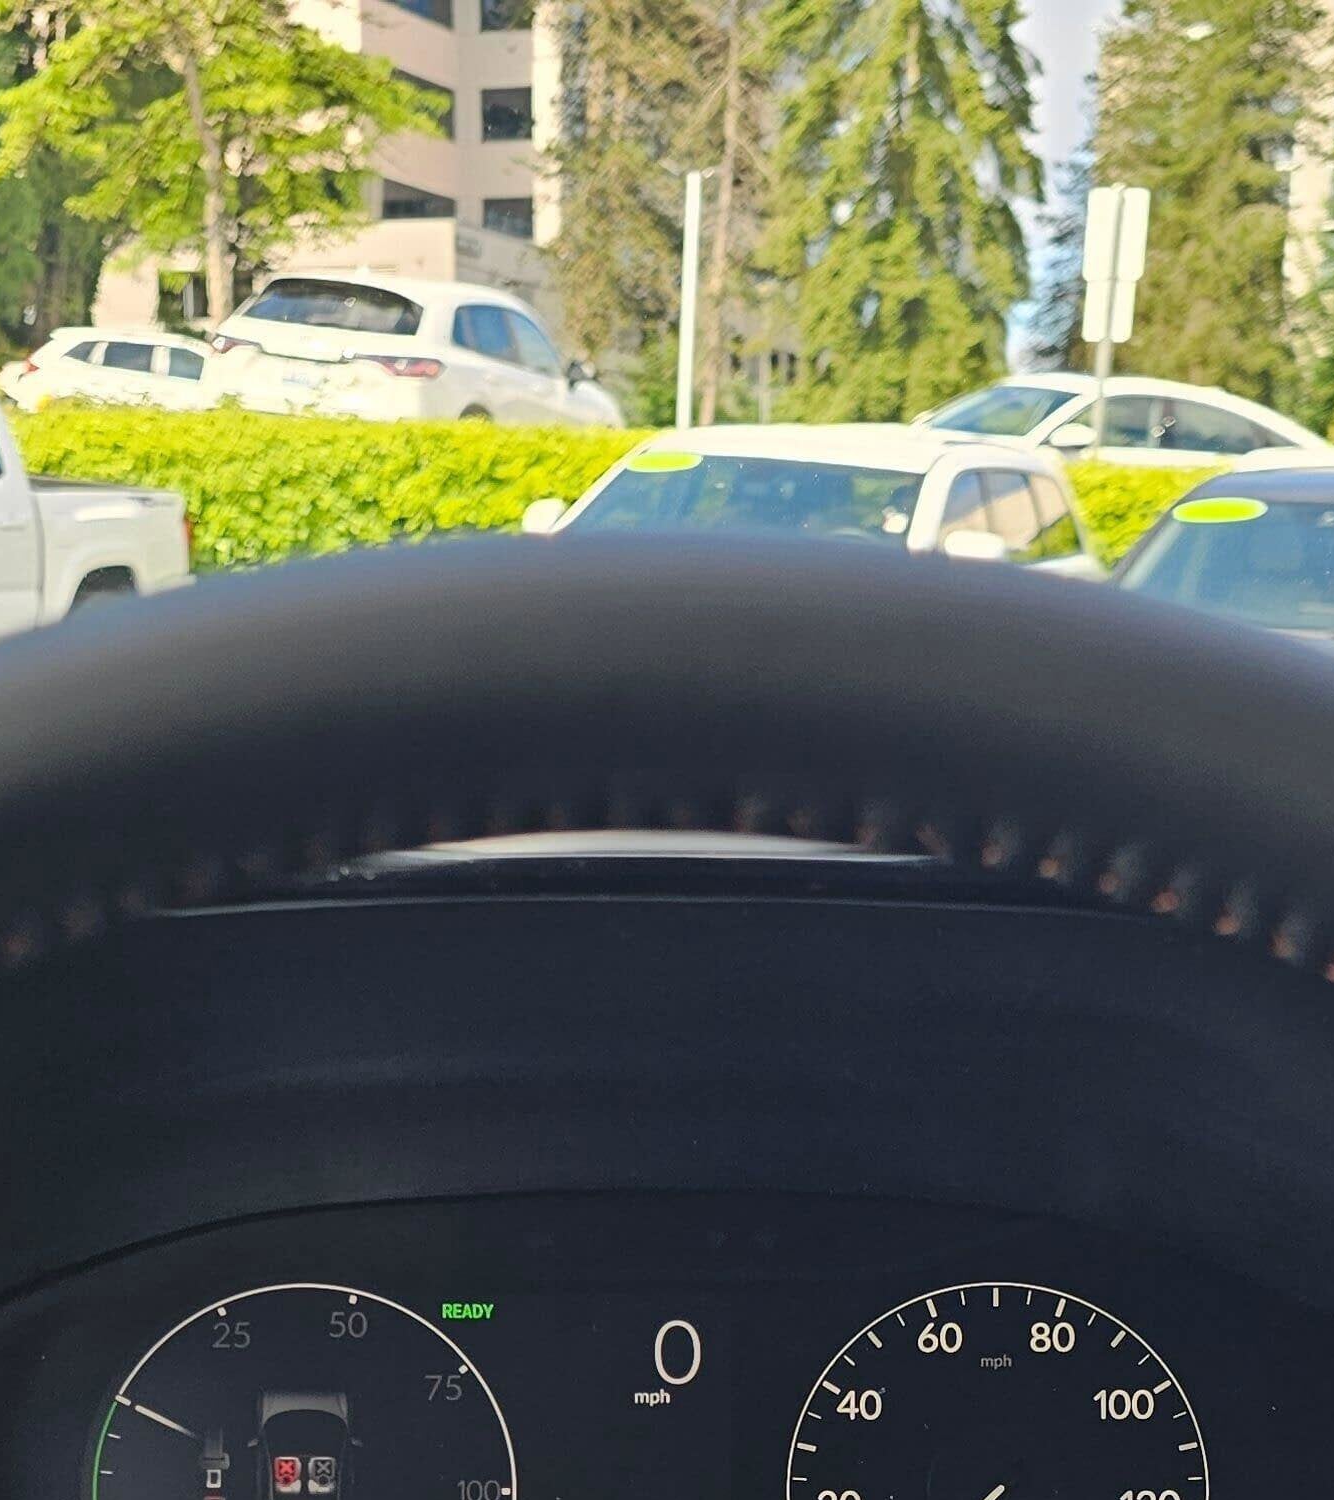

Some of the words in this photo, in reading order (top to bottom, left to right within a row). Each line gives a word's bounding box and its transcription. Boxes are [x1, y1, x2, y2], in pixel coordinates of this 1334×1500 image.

[328, 1312, 367, 1339] 50
[442, 1303, 494, 1321] READY
[211, 1322, 251, 1349] 25
[916, 1321, 963, 1354] 60
[1029, 1321, 1076, 1354] 80
[654, 1319, 701, 1385] 0
[979, 1354, 1013, 1370] mph
[424, 1374, 463, 1402] 75
[634, 1389, 671, 1406] mph
[836, 1389, 883, 1421] 40
[1092, 1389, 1155, 1421] 100
